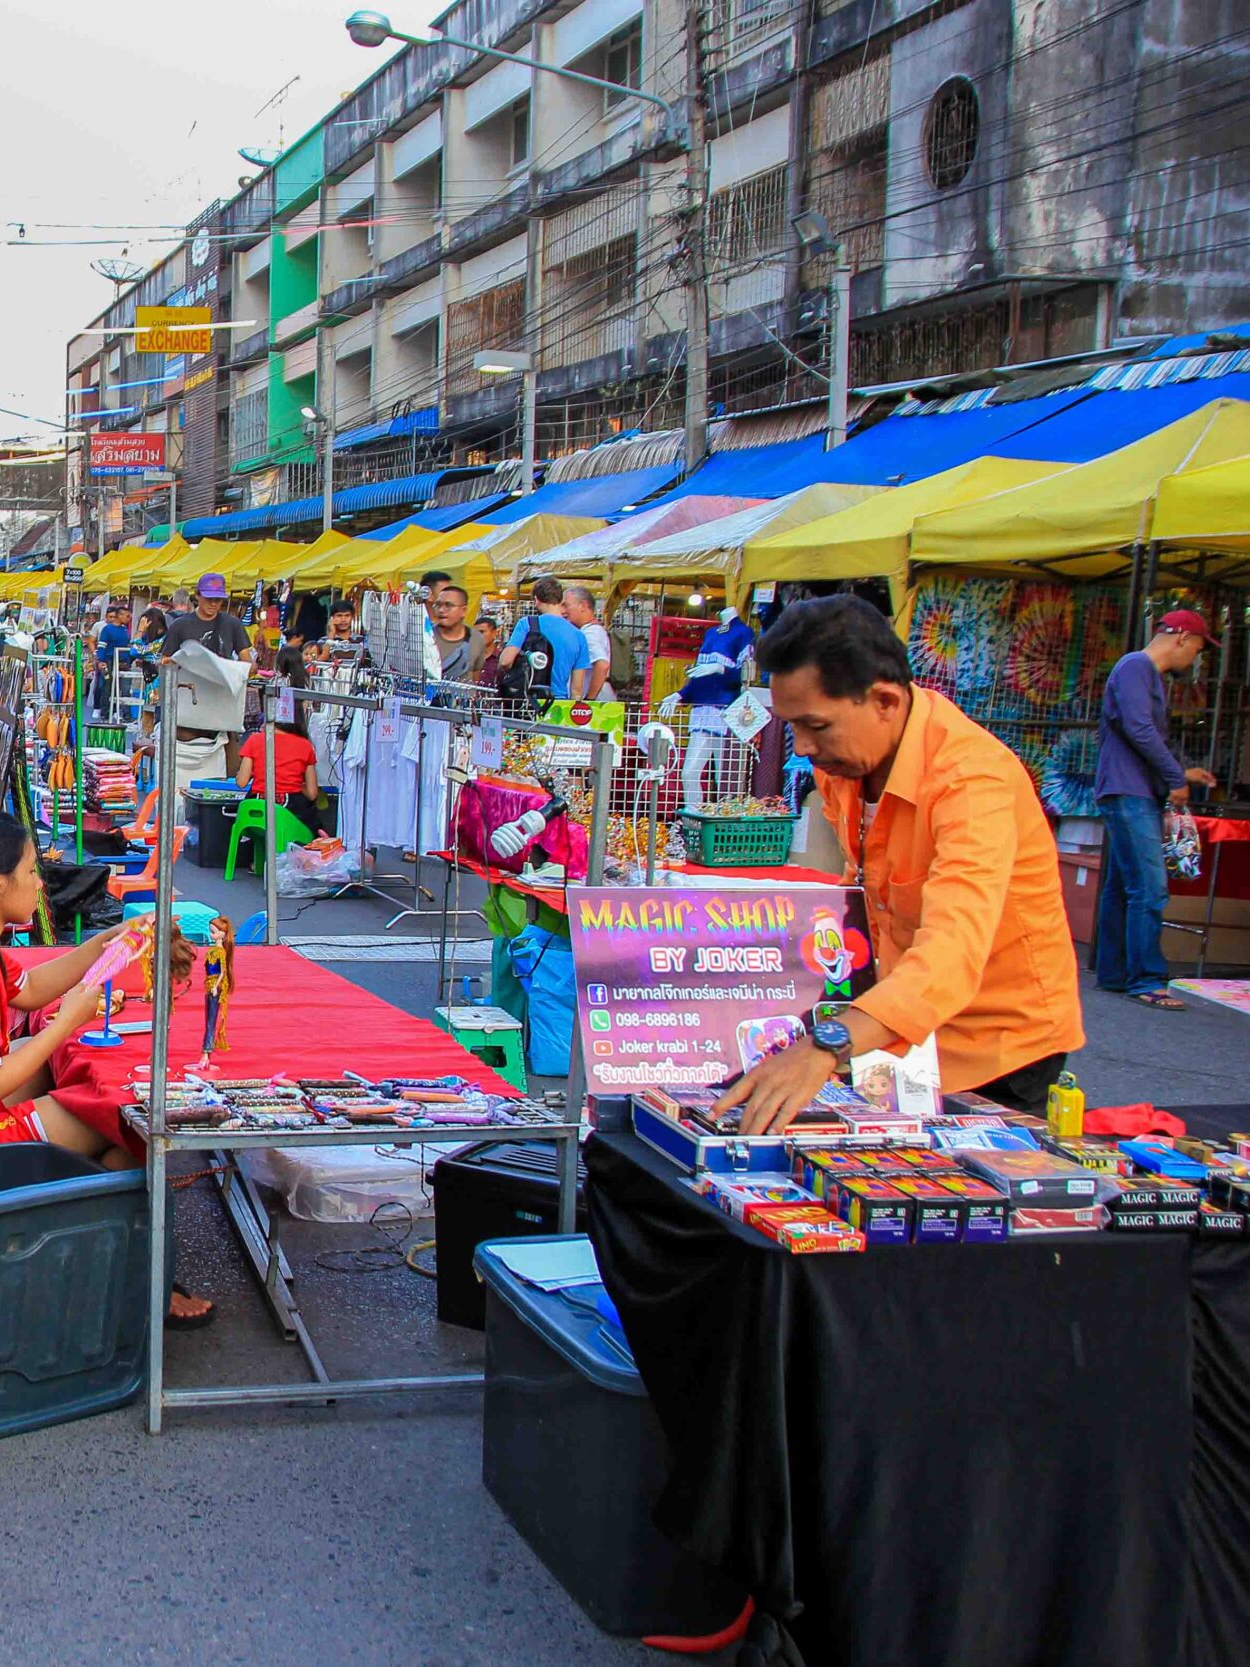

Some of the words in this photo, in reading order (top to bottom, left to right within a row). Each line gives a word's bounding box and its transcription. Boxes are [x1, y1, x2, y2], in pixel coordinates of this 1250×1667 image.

[139, 329, 208, 351] EXCHANGE
[571, 708, 592, 716] OTOP
[579, 898, 698, 935] MAGIC
[704, 896, 795, 934] SHOP
[650, 947, 686, 972] BY
[694, 946, 783, 972] JOKER
[766, 979, 796, 1001] กระบี่
[616, 1012, 701, 1028] 098-6896186
[619, 1040, 654, 1054] Joker
[656, 1039, 689, 1053] krabi
[691, 1039, 722, 1053] 1-24
[1121, 1192, 1157, 1204] MAGIC
[1162, 1191, 1198, 1203] MAGIC
[764, 1205, 829, 1222] UNO
[1118, 1215, 1154, 1226] MAGIC
[1159, 1214, 1195, 1226] MAGIC
[1205, 1217, 1242, 1229] MAGIC
[794, 1238, 818, 1252] UNO
